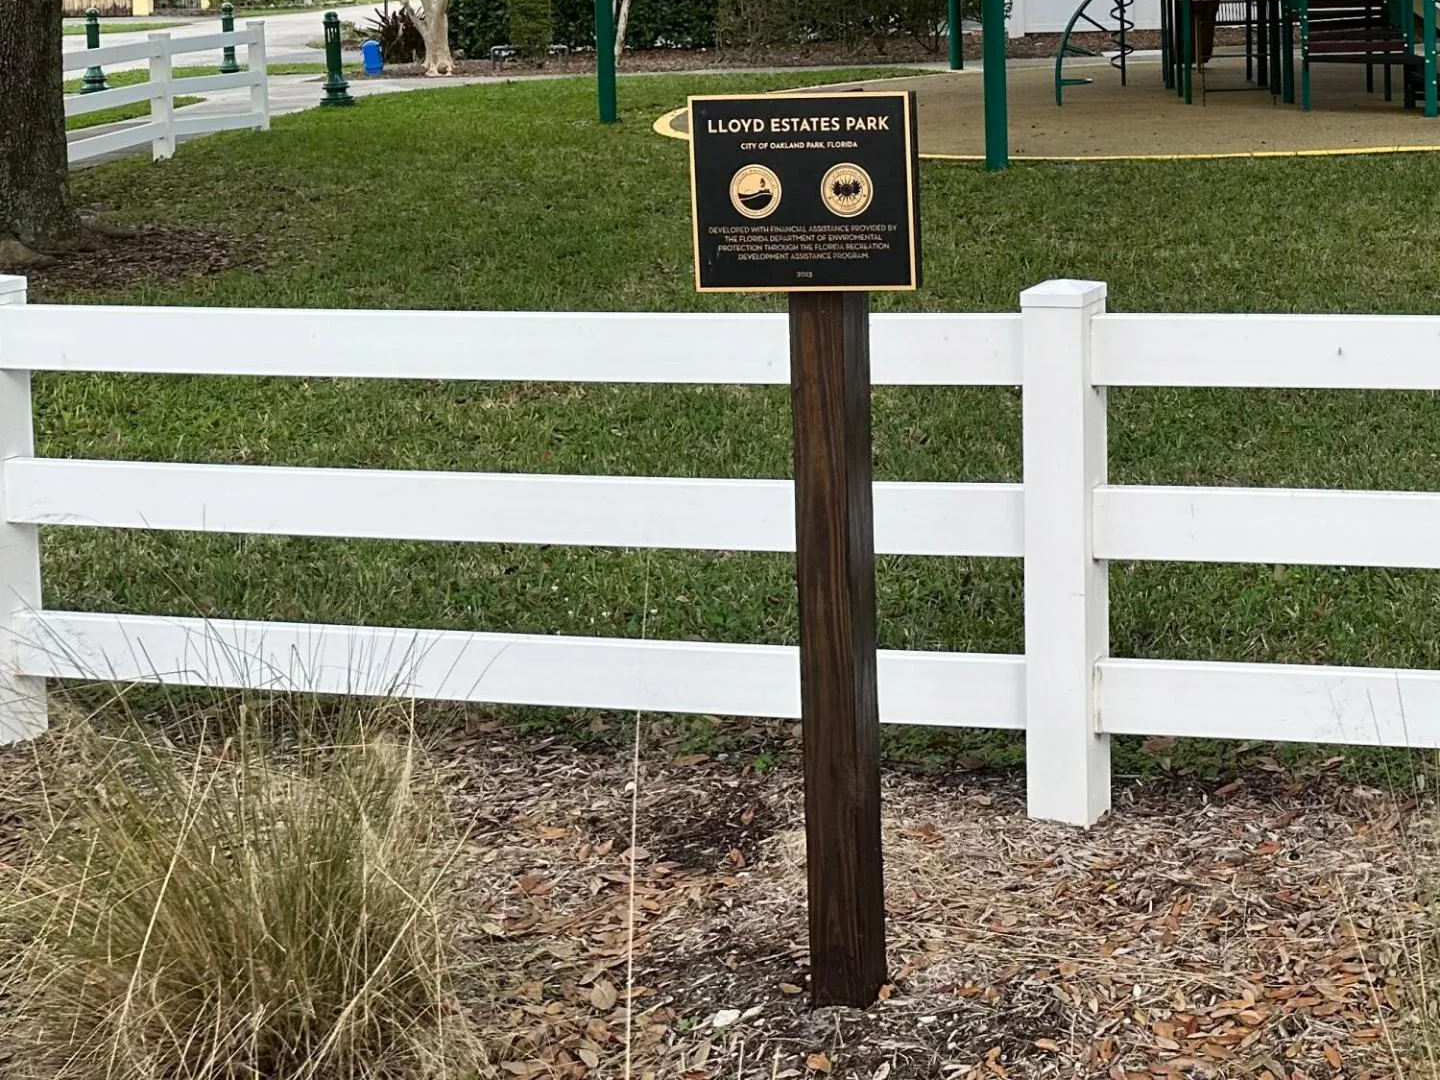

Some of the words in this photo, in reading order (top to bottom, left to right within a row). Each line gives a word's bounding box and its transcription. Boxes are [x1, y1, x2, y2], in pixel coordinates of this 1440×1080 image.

[707, 119, 765, 133] LLOYD
[770, 117, 840, 132] ESTATES
[846, 116, 890, 131] PARK
[741, 142, 757, 150] CITY
[806, 142, 825, 150] PARK,
[827, 141, 858, 149] FLORIDA
[708, 226, 750, 234] DEVELOPED
[770, 225, 807, 233] FINANCIAL
[850, 224, 886, 232] PROVIDED
[770, 234, 815, 242] DEPARTMENT
[718, 244, 762, 252] PROTECTION
[814, 243, 844, 251] FLORIDA
[790, 252, 831, 260] ASSISTANCE
